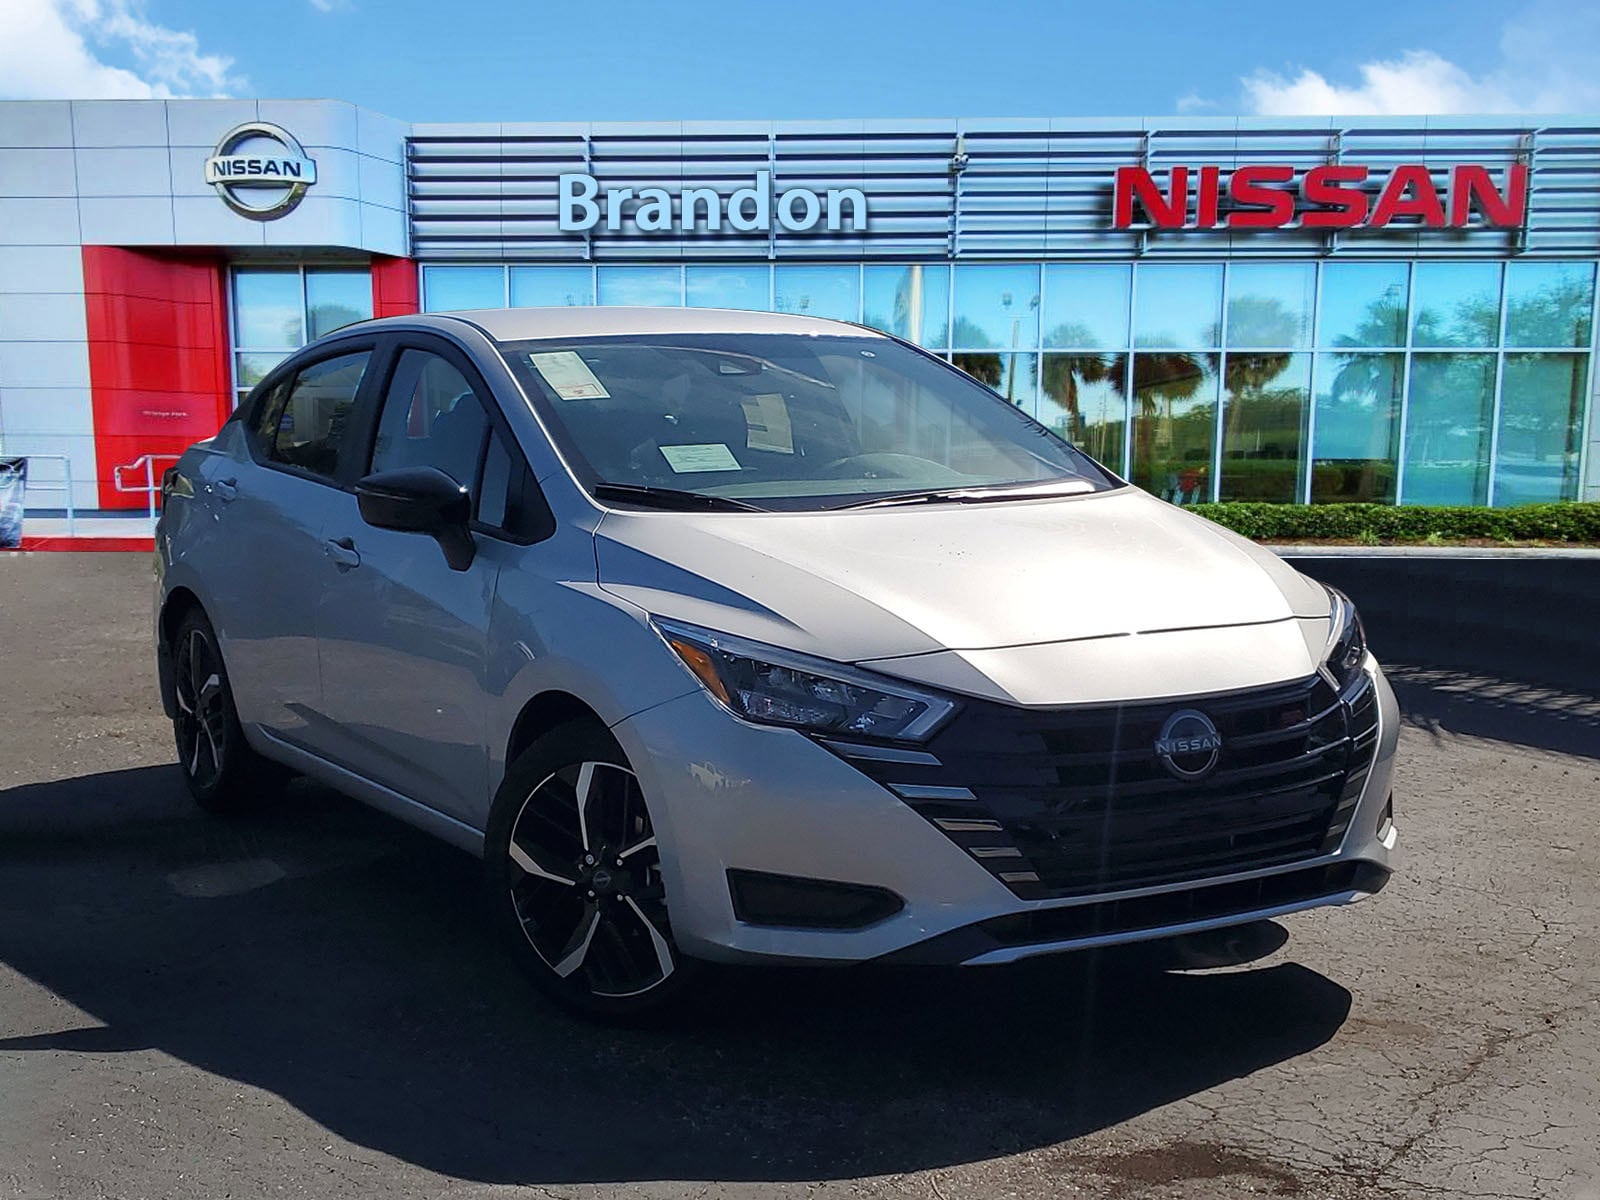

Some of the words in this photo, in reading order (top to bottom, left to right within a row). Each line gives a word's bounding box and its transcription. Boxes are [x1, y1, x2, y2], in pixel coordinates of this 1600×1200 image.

[213, 160, 301, 177] NISSAN
[559, 170, 867, 231] Brandon
[1113, 165, 1528, 229] NISSAN
[1156, 735, 1222, 755] NISSAN
